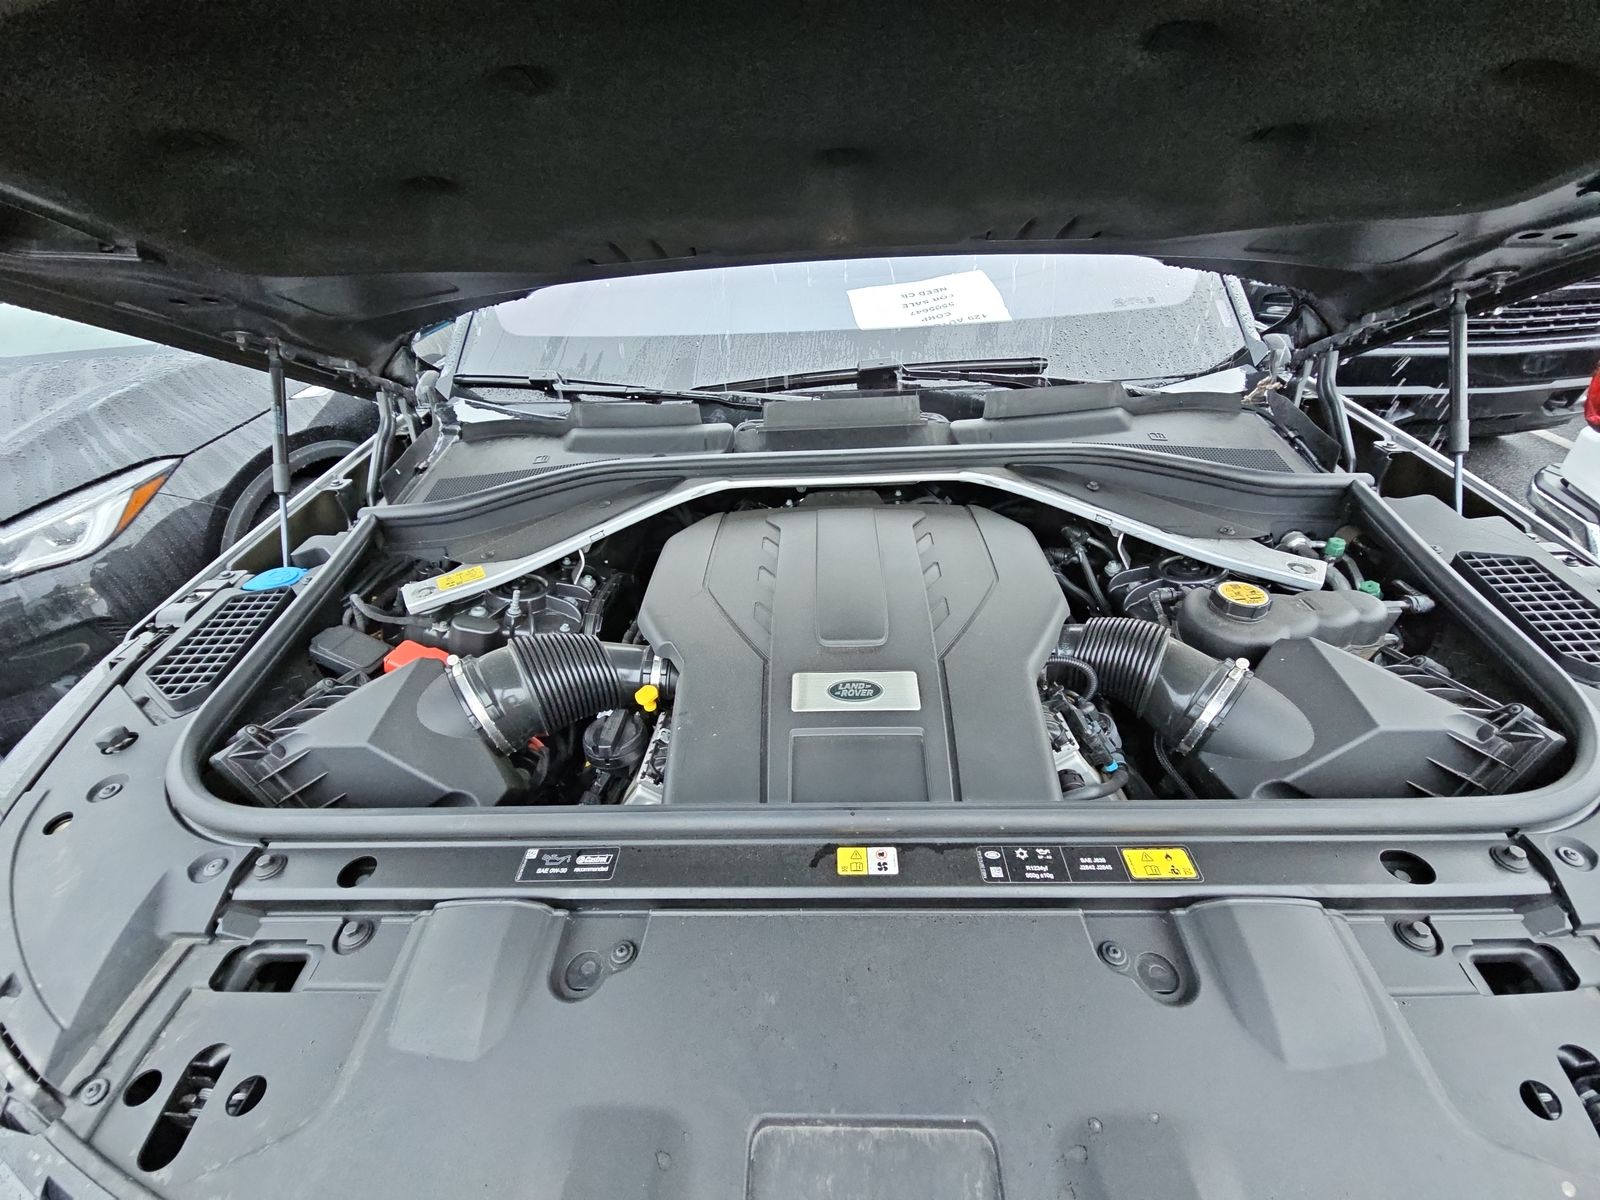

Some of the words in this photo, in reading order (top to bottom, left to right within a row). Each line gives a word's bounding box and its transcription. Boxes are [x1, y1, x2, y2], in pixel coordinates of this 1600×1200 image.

[919, 286, 948, 297] NEED
[933, 294, 954, 303] FOR
[902, 300, 929, 309] SALE
[921, 312, 952, 323] CORP
[840, 689, 874, 697] ROVER
